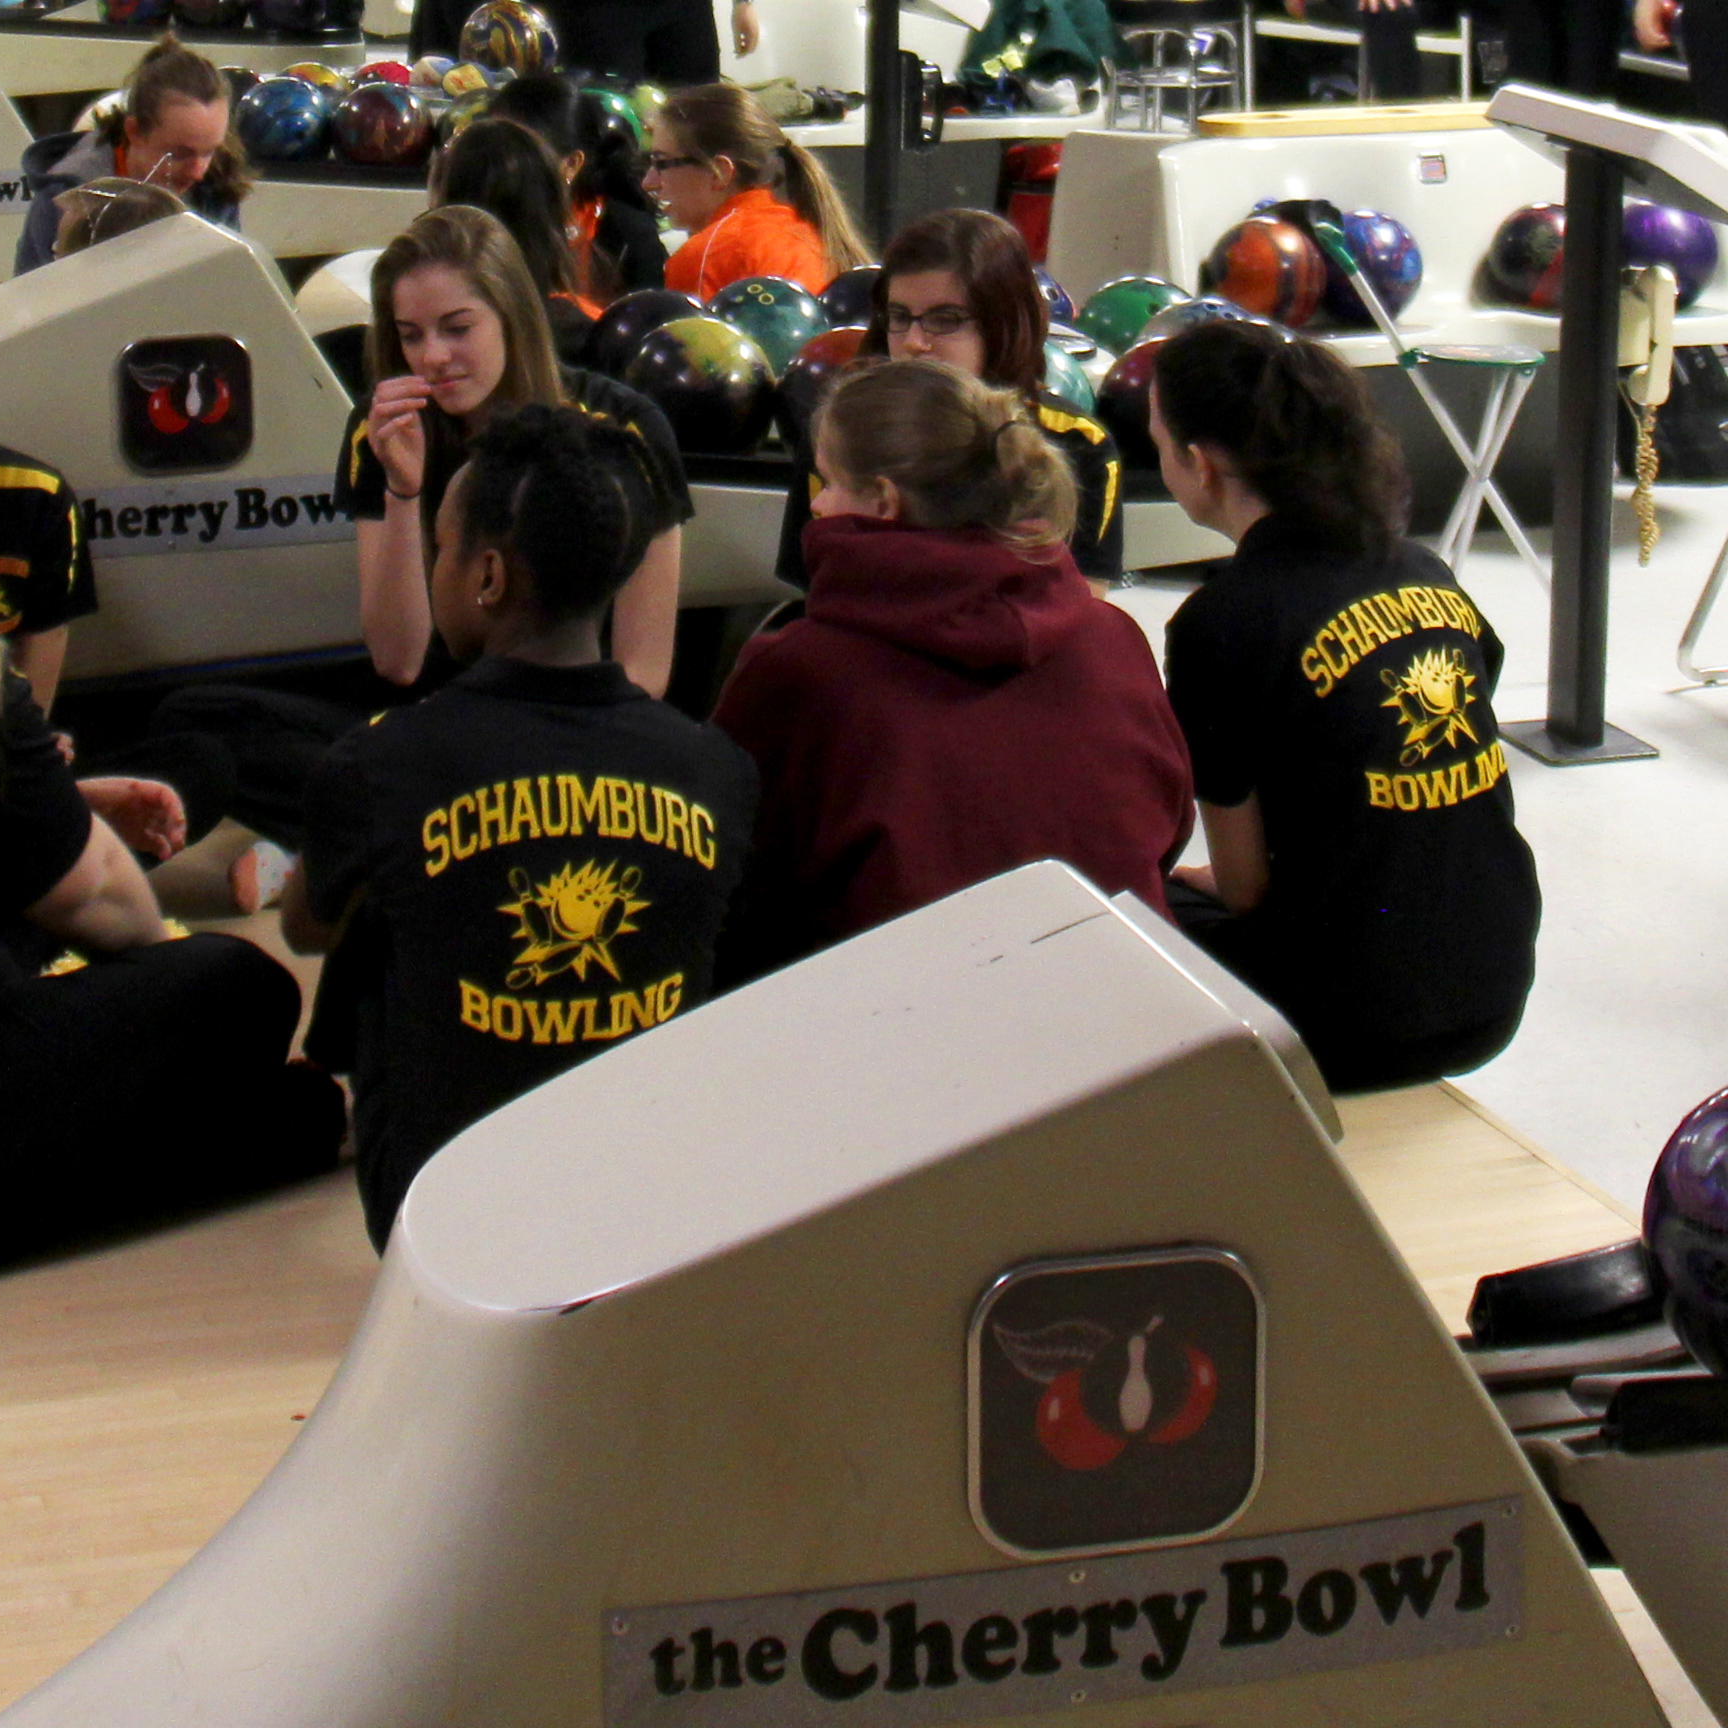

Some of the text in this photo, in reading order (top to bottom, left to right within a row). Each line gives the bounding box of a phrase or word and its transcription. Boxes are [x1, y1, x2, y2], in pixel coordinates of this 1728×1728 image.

[81, 487, 344, 543] herry Bow
[1301, 586, 1481, 698] SCHAUMBUR
[1365, 741, 1508, 811] BOWLIN
[422, 774, 715, 878] SCHAUMBURG
[458, 972, 684, 1044] BOWLING
[649, 1521, 1490, 1701] the Cherry Bowl
